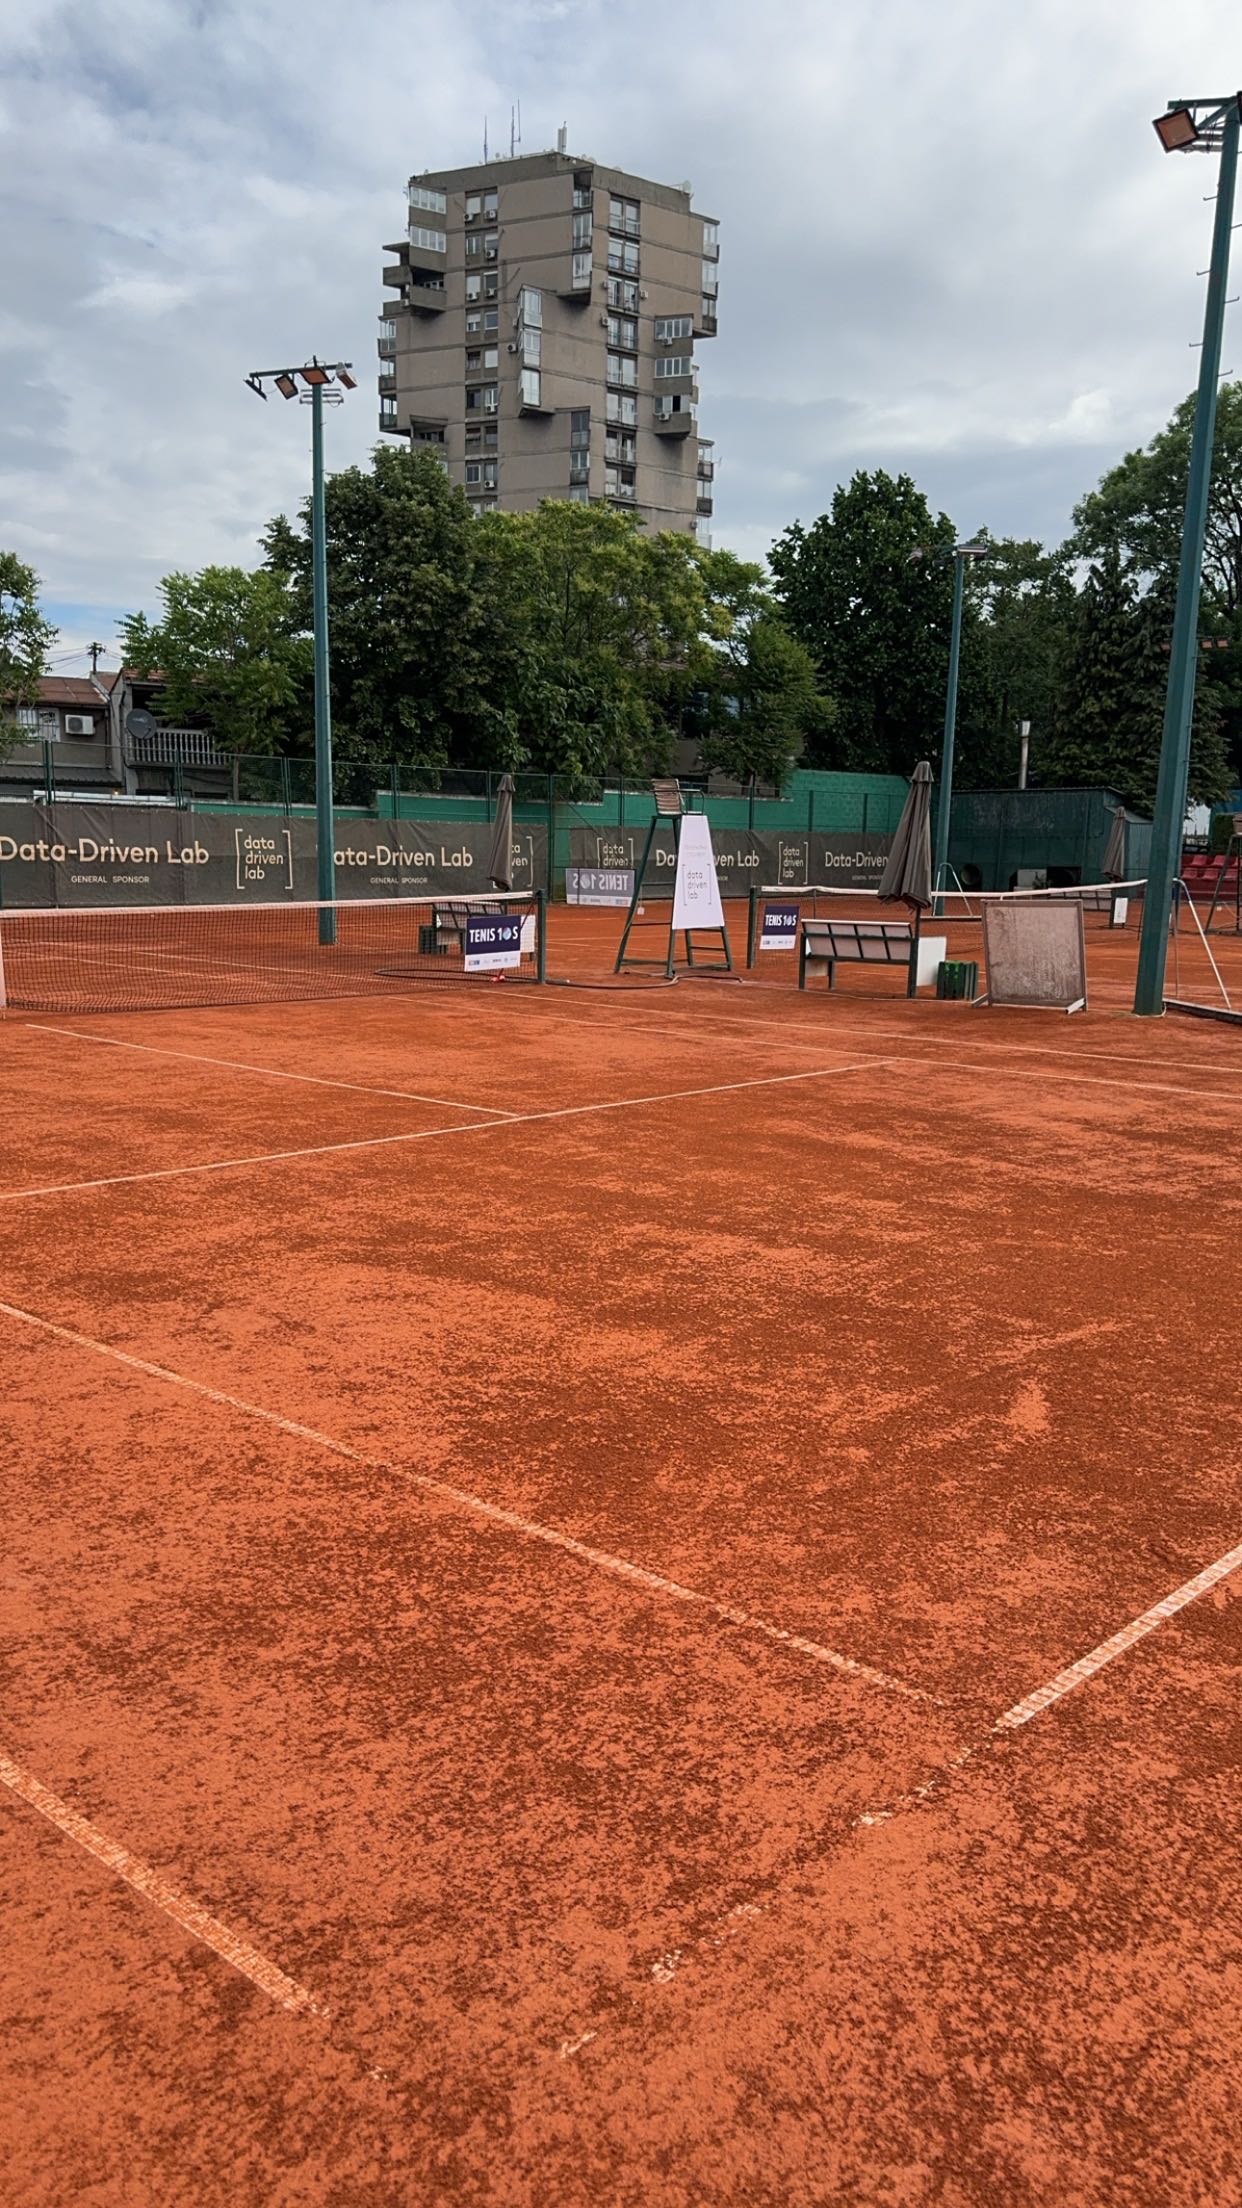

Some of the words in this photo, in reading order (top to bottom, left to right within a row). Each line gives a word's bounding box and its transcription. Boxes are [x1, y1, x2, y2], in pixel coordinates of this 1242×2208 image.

[244, 835, 275, 849] data
[603, 843, 624, 854] data
[0, 836, 158, 863] Data-Driven
[166, 841, 209, 864] Lab
[334, 845, 435, 866] ata-Driven
[441, 847, 473, 867] Lab
[783, 847, 800, 856] data
[245, 851, 284, 864] driven
[737, 850, 760, 867] Lab
[783, 856, 804, 867] driven
[245, 866, 265, 879] lab
[783, 867, 795, 878] lab
[765, 914, 782, 926] TENIS
[469, 928, 496, 943] TENIS
